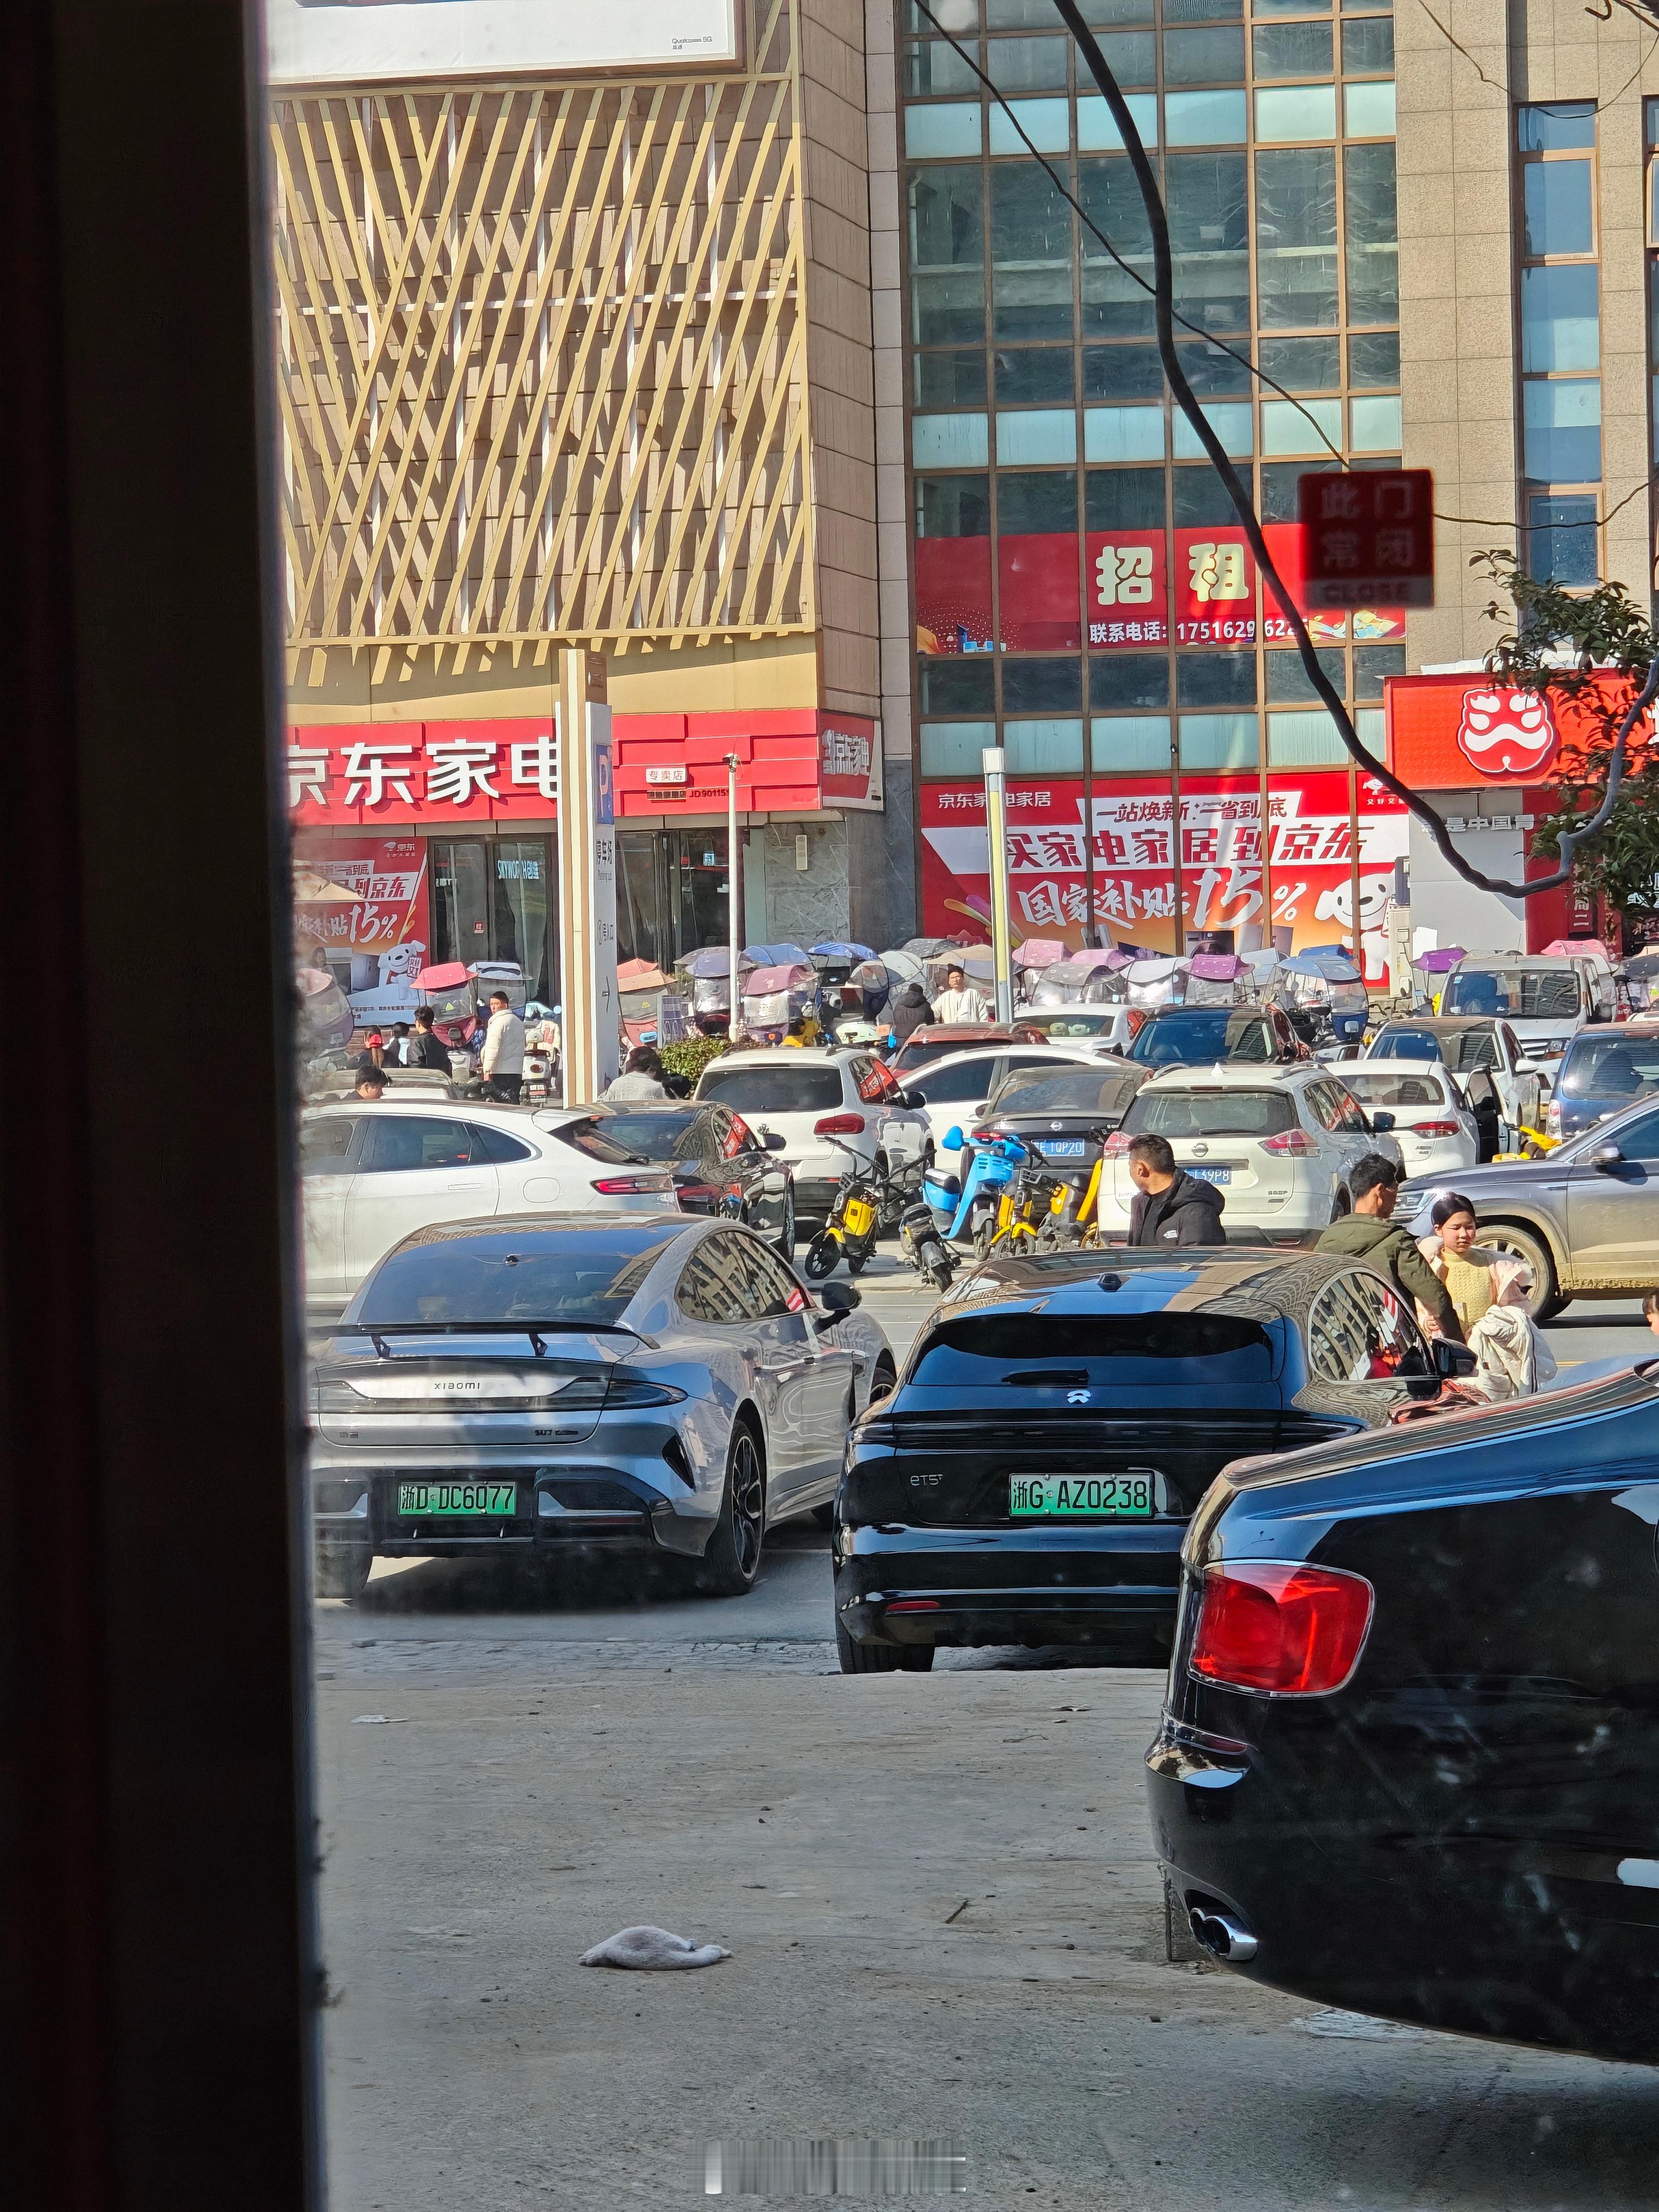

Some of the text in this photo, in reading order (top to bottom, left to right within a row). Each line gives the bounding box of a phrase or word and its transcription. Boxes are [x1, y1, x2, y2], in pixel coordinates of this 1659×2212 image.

[1095, 542, 1249, 605] 招租
[1177, 618, 1309, 639] 175162962
[649, 770, 683, 781] 专卖店
[1006, 824, 1375, 868] 买家电家居到京东
[434, 1381, 481, 1390] xiaomi
